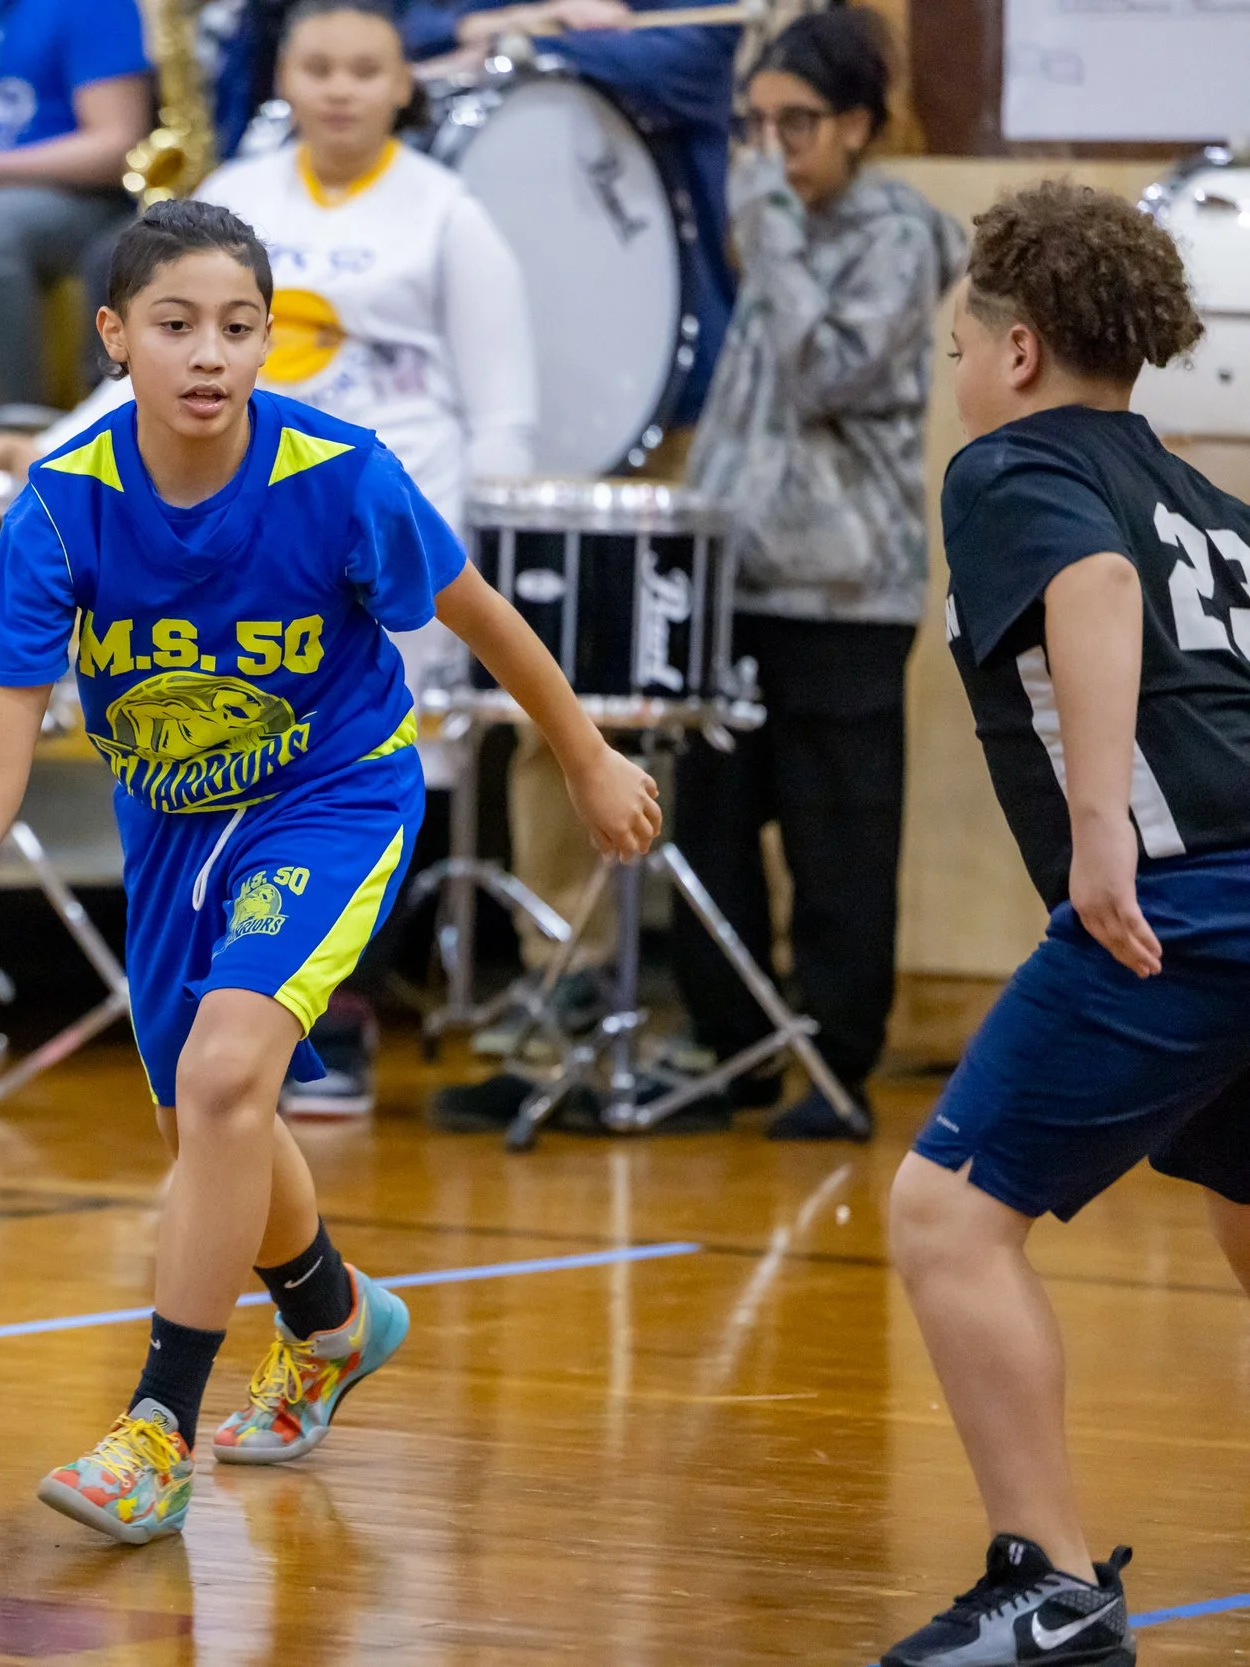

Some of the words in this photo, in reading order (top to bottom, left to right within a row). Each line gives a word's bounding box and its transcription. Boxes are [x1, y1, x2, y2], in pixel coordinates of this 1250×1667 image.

[1153, 501, 1250, 663] 23
[79, 610, 217, 678] M.S.
[236, 614, 325, 676] 50
[273, 866, 310, 896] 50
